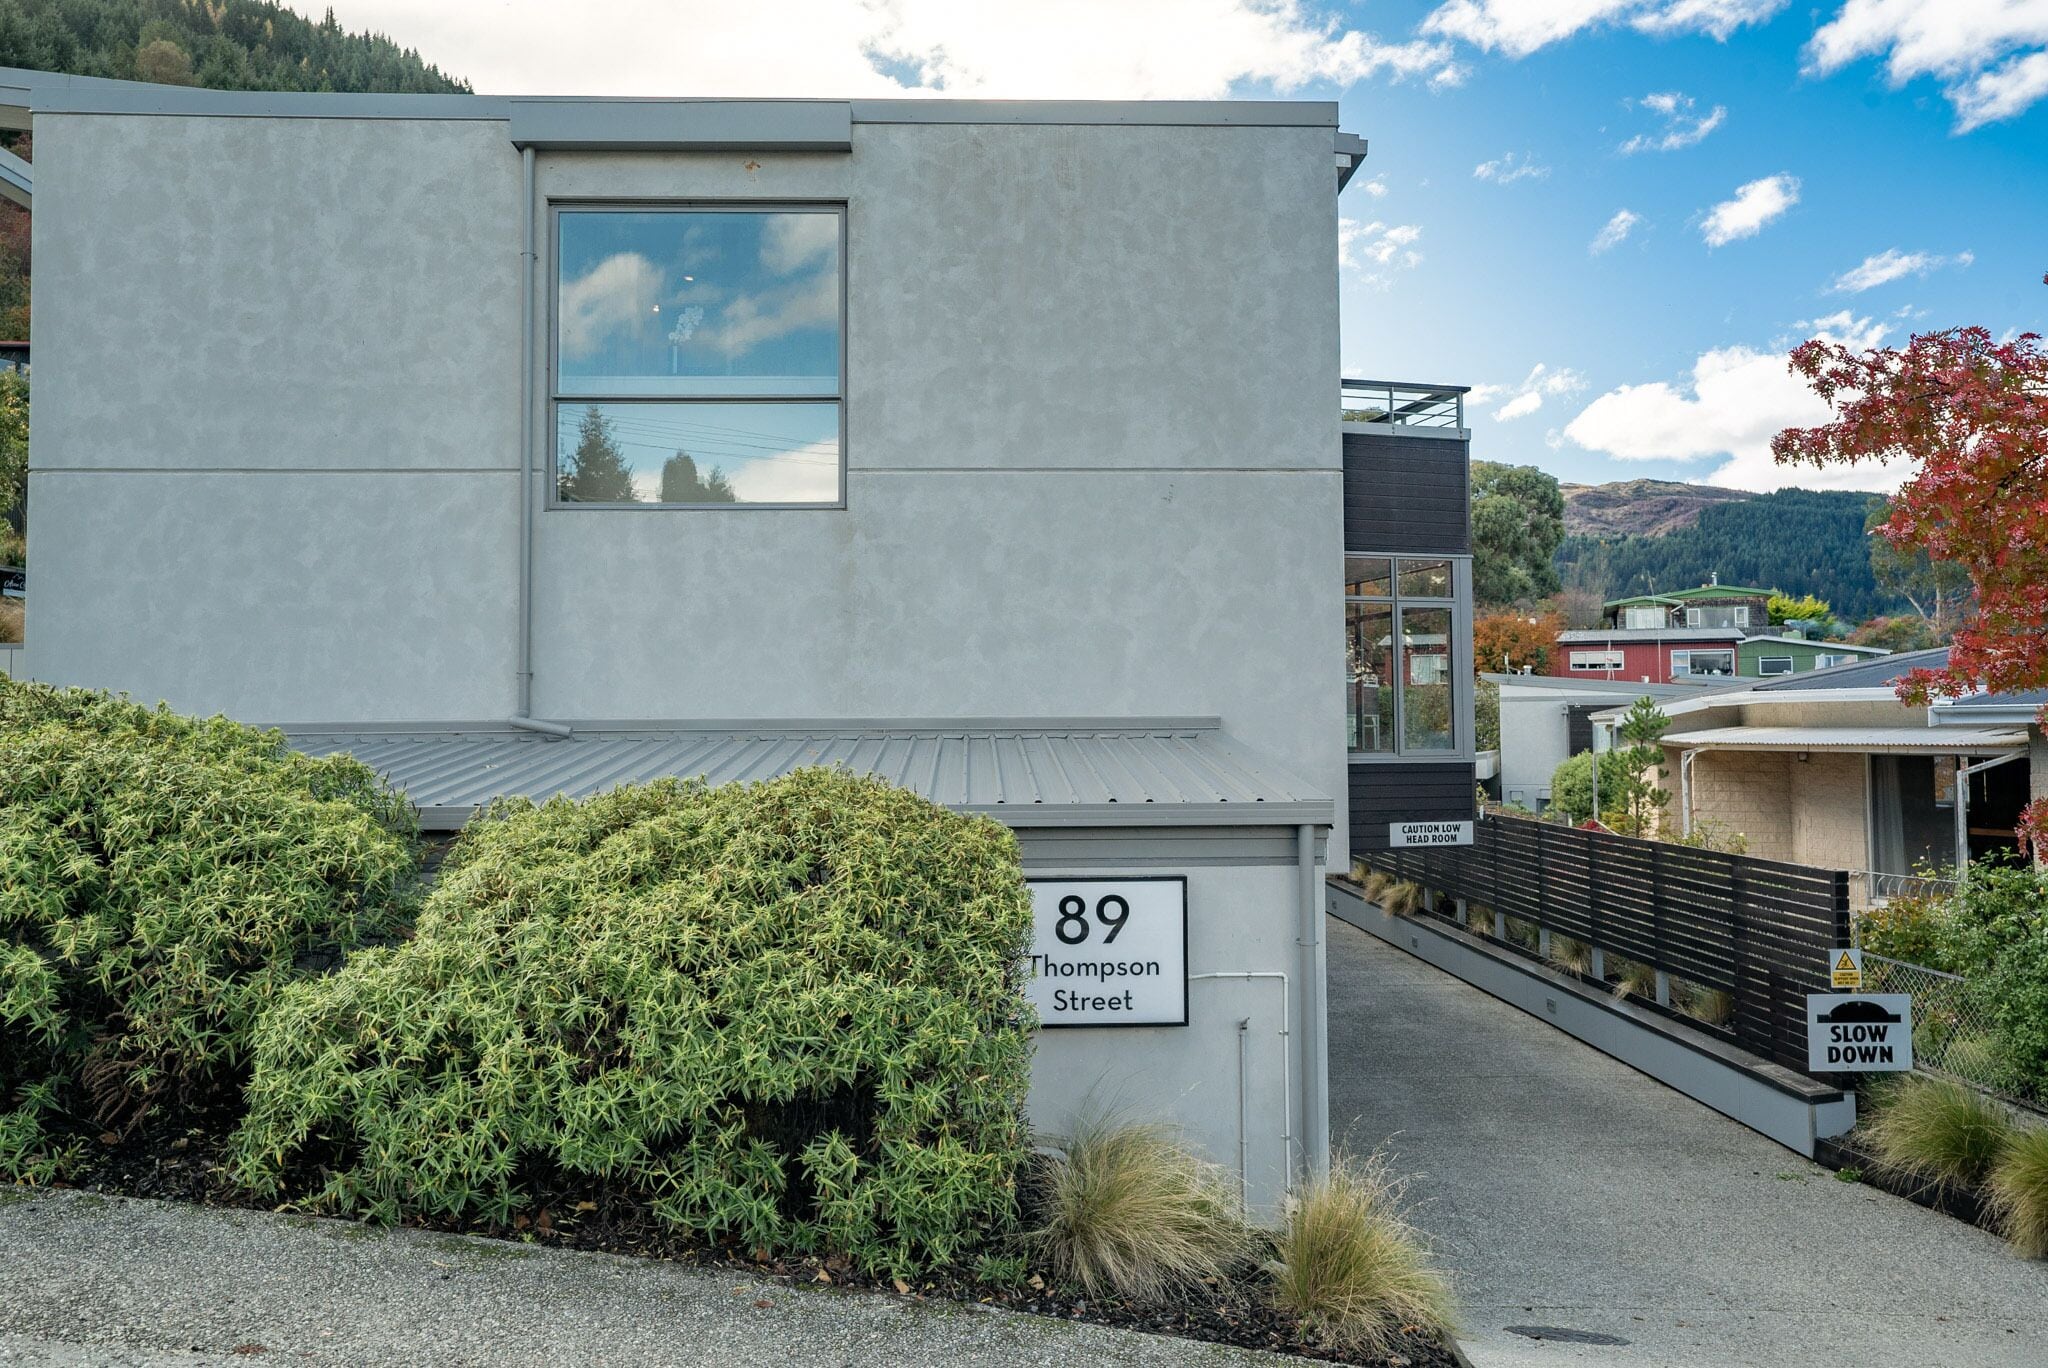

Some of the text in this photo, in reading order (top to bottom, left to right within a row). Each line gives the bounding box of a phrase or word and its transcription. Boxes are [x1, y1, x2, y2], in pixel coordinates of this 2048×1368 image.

[1402, 824, 1461, 834] CAUTION LOW
[1406, 834, 1457, 844] HEAD ROOM
[1055, 894, 1130, 945] 89
[1028, 953, 1160, 983] Thompson
[1053, 989, 1133, 1011] Street
[1830, 1025, 1888, 1043] SLOW
[1827, 1046, 1894, 1063] DOWN
